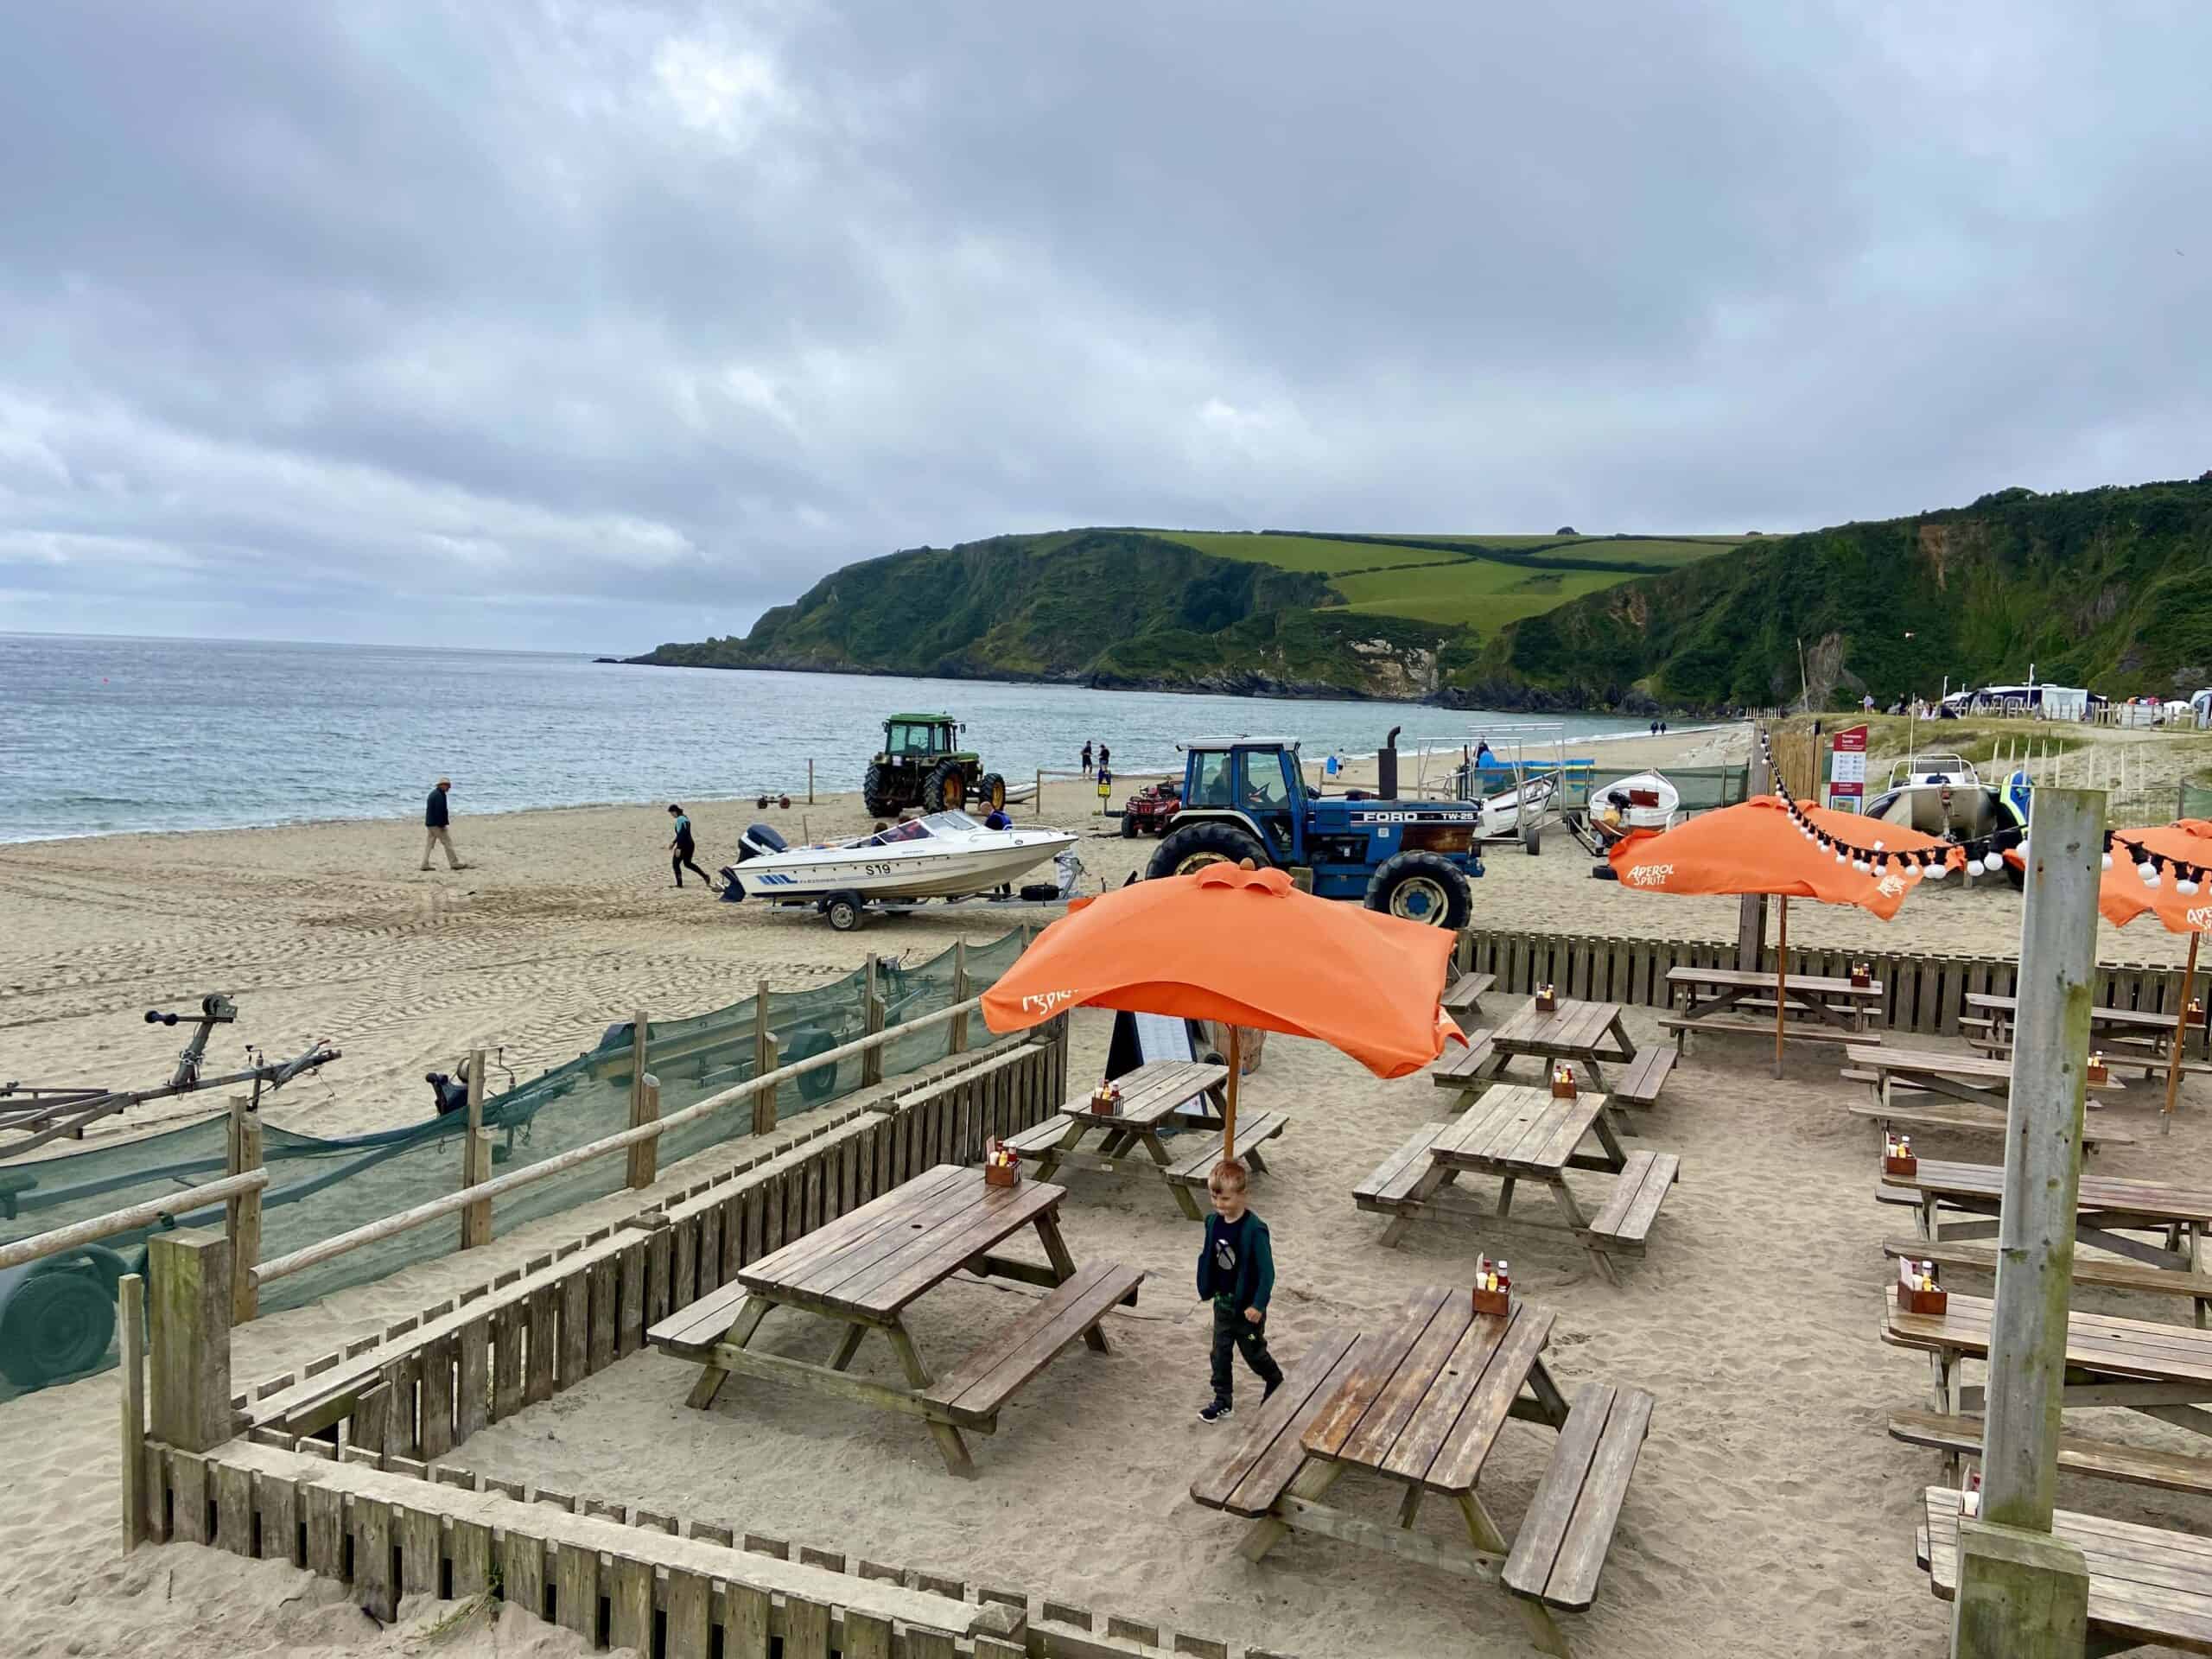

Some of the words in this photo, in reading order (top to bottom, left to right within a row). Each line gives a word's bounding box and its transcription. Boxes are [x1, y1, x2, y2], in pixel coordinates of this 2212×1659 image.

[1363, 812, 1418, 823] FORD
[865, 863, 891, 875] S19
[1626, 863, 1674, 879] APEROL
